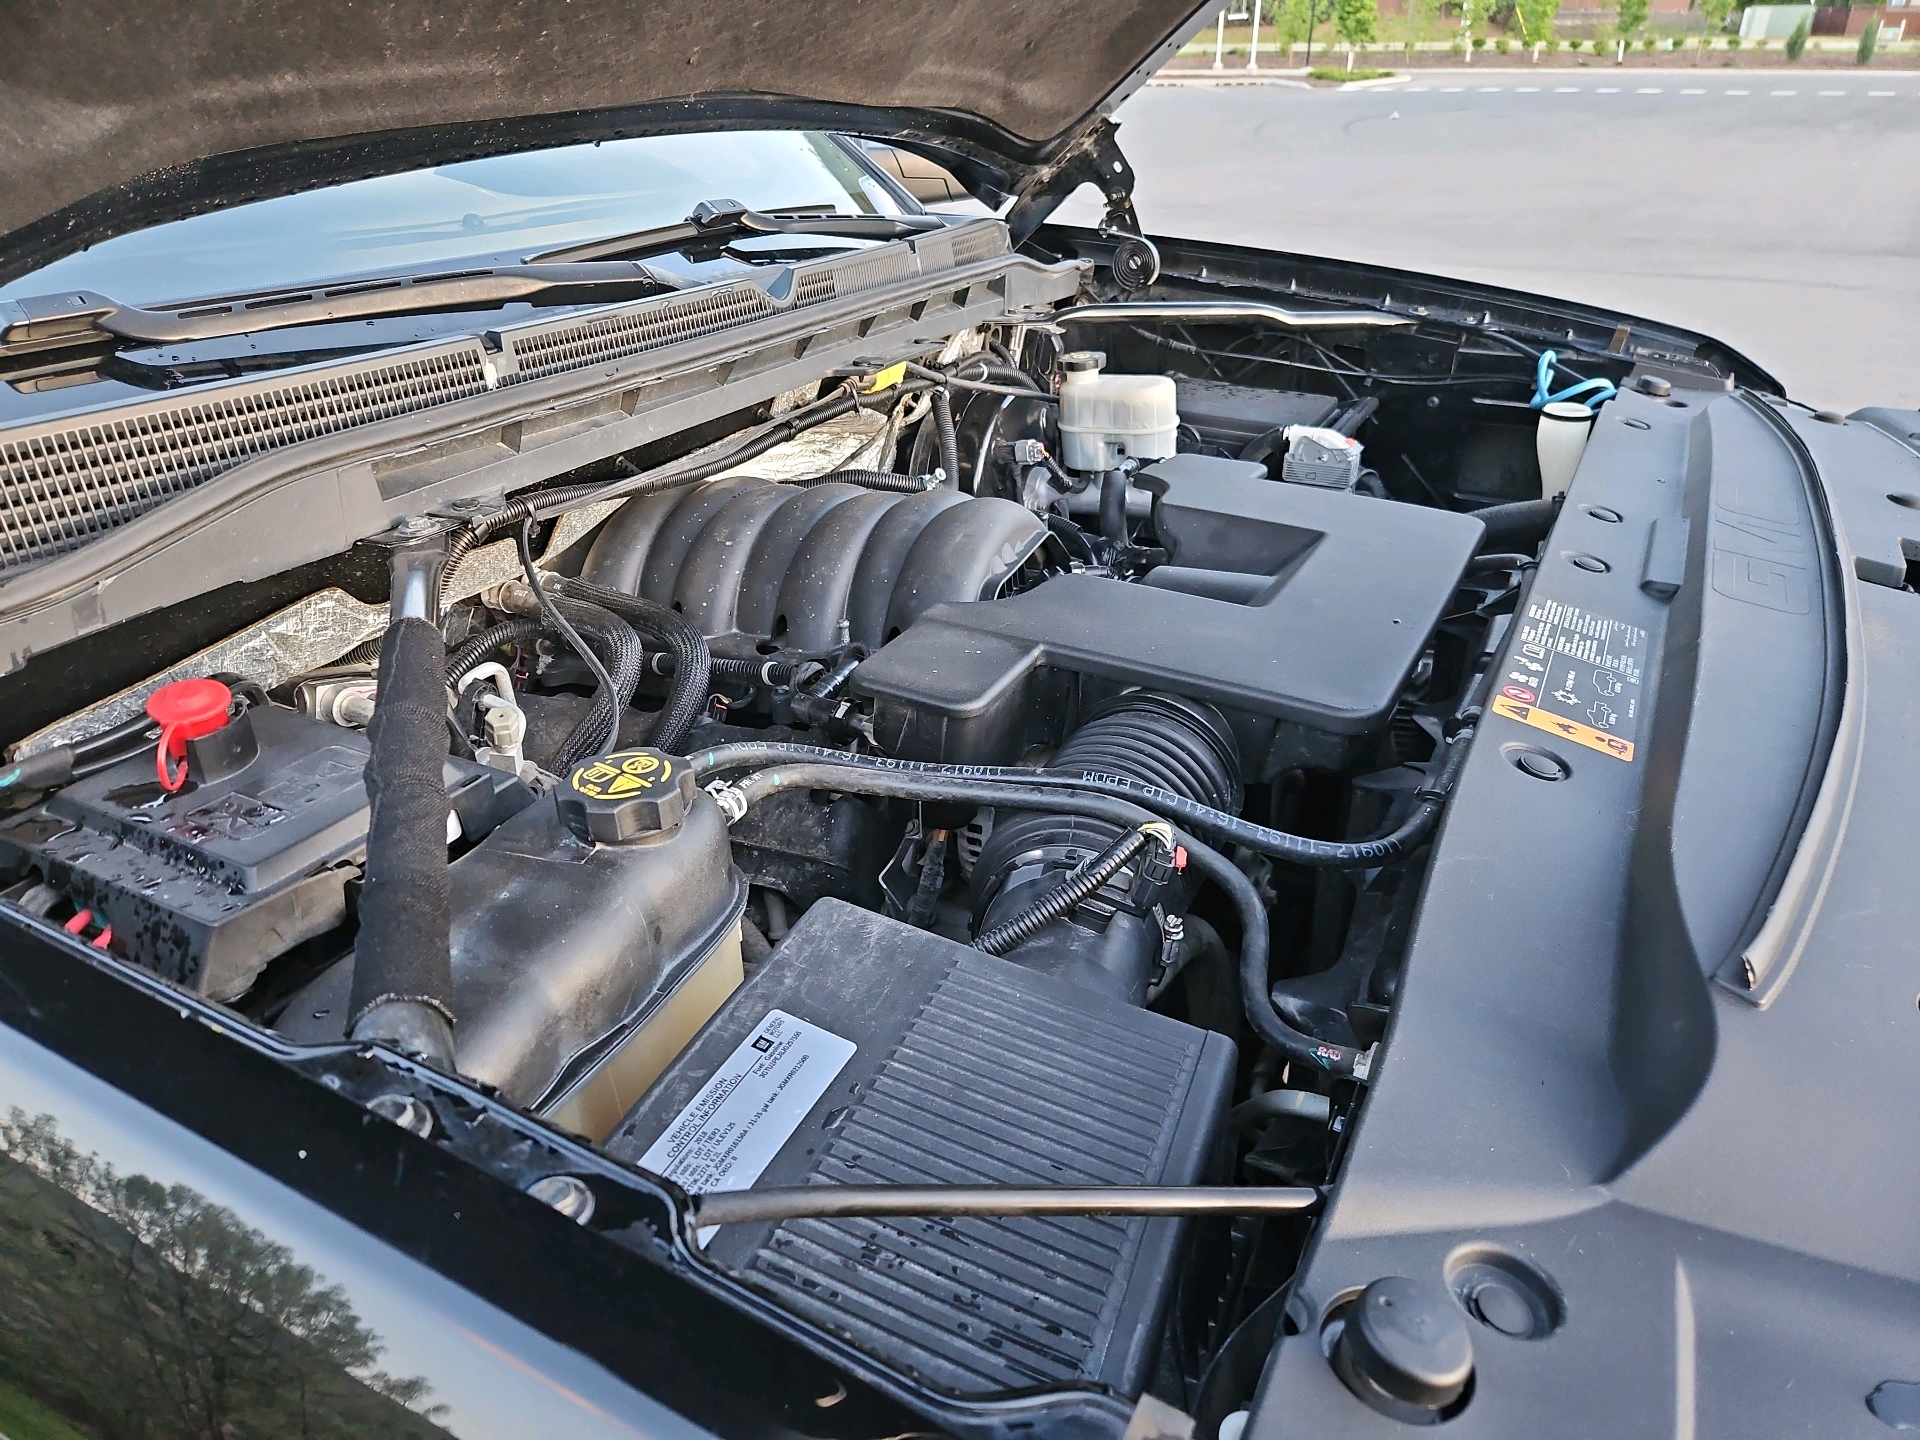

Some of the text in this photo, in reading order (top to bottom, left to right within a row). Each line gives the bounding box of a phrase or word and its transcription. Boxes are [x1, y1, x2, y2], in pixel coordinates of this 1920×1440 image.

[513, 589, 529, 597] OUT
[763, 1016, 781, 1033] GENERAL
[769, 1020, 785, 1036] MOTORS
[774, 1030, 783, 1038] LLC
[752, 1040, 784, 1074] Fuel: Gasoline
[666, 1073, 742, 1159] CONTROL INFORMATION
[667, 1078, 728, 1144] VEHICLE EMISSION
[667, 1130, 708, 1178] egulations: 2018
[692, 1147, 704, 1160] LDT
[704, 1128, 721, 1145] TIER3
[701, 1149, 713, 1161] LDT
[713, 1121, 736, 1146] ULEV125
